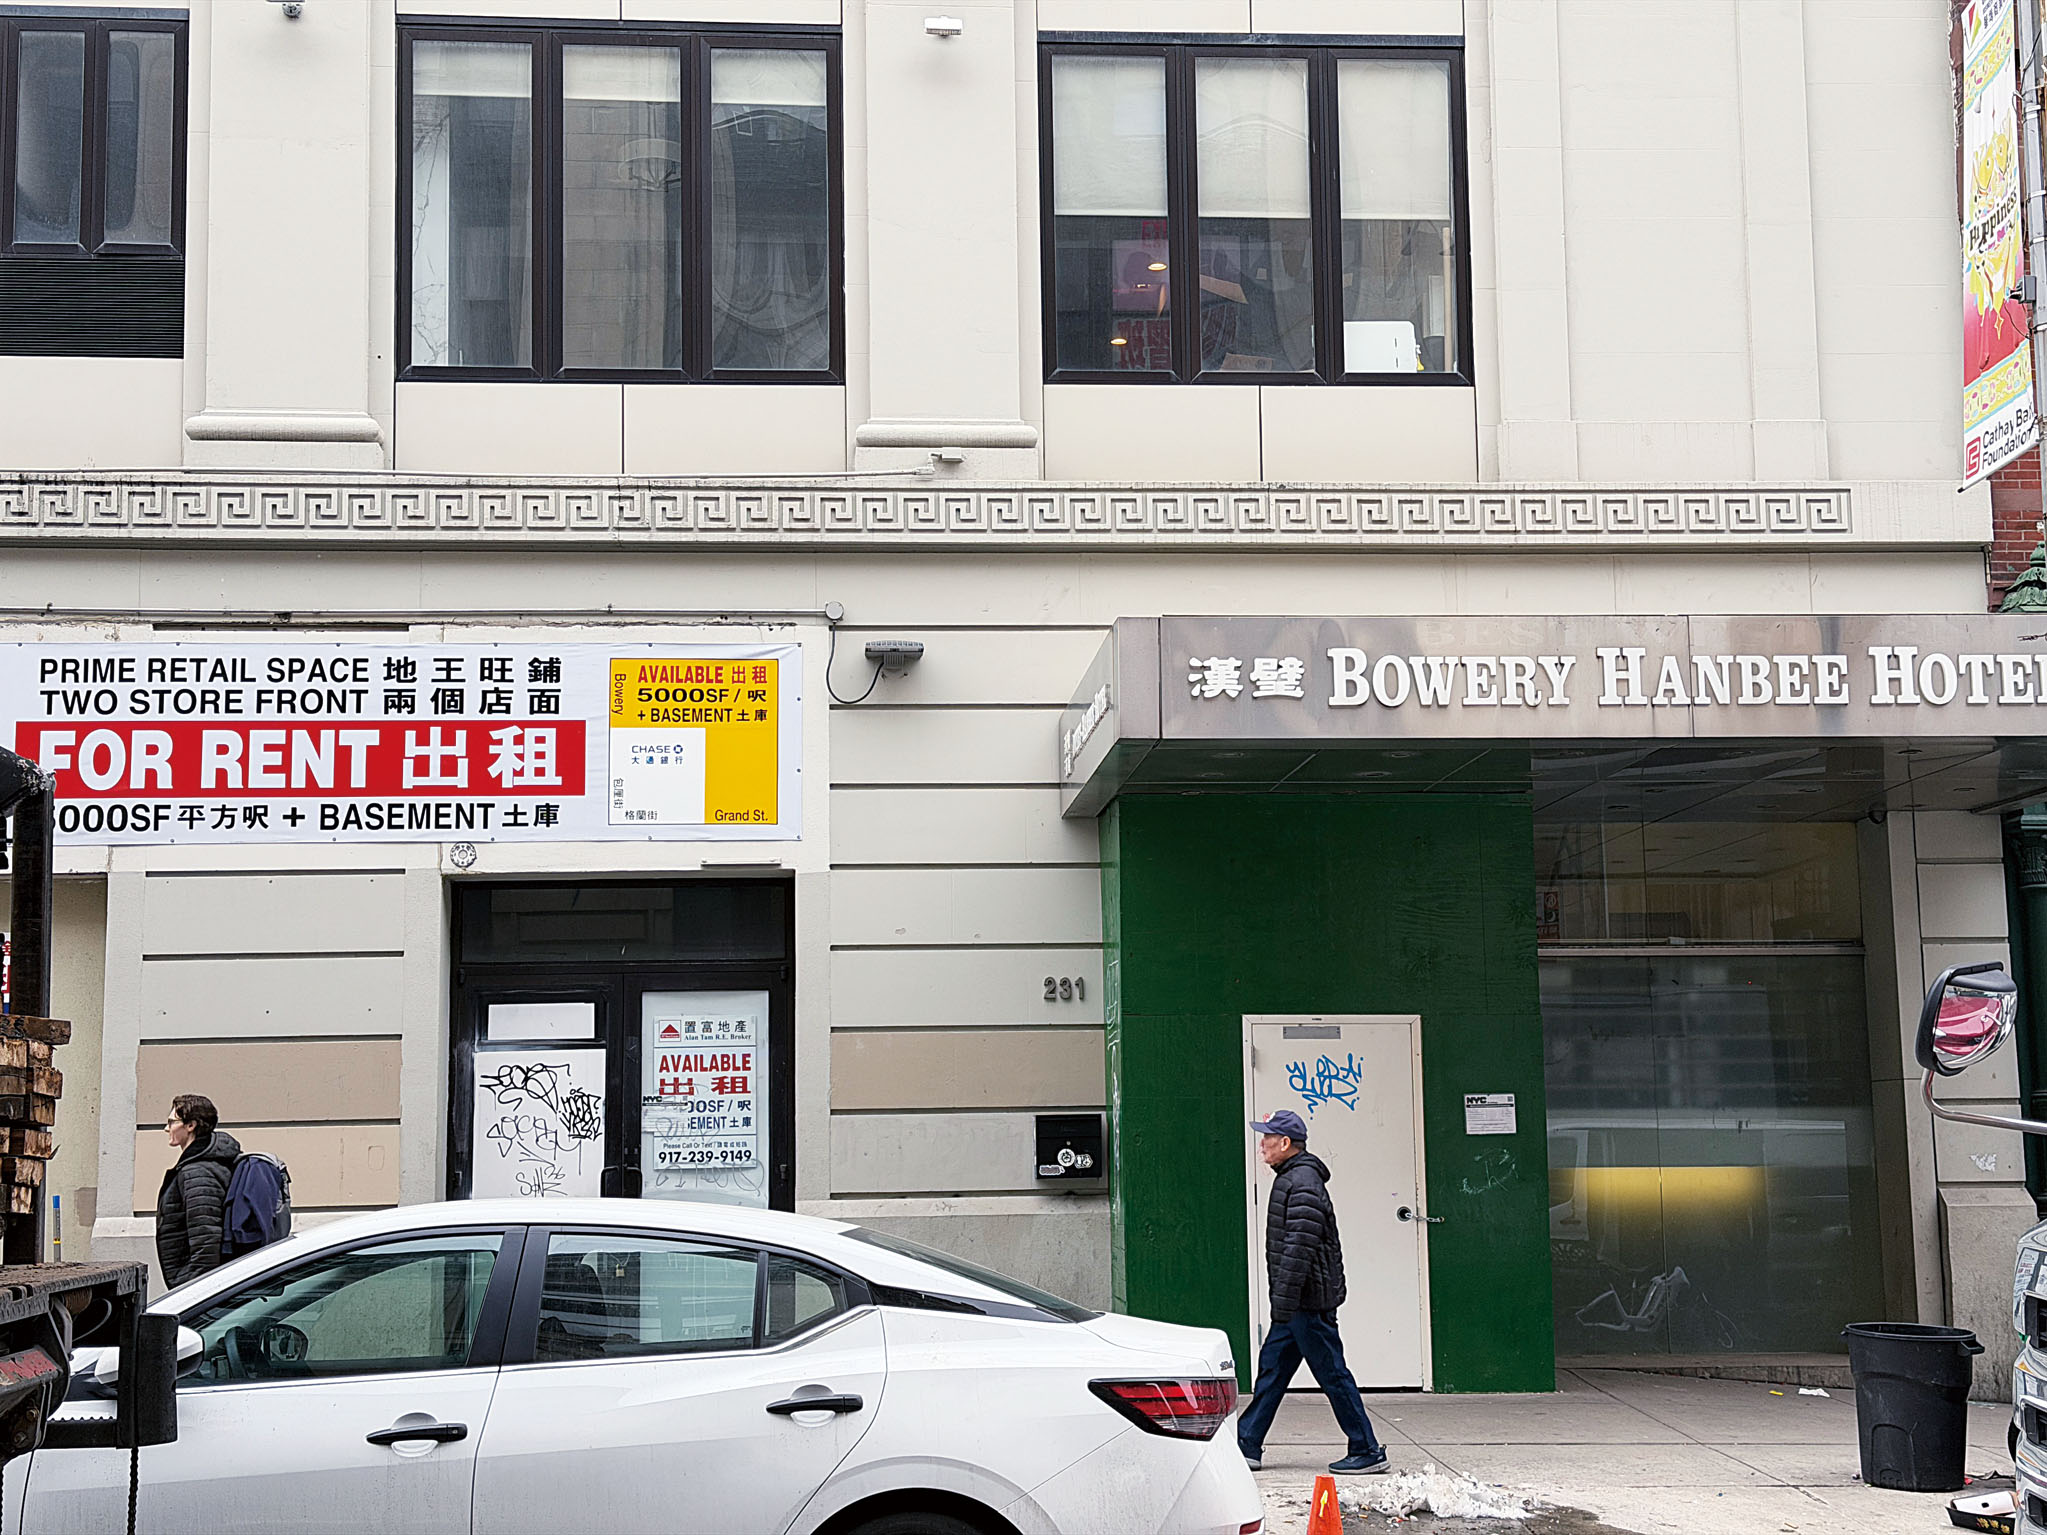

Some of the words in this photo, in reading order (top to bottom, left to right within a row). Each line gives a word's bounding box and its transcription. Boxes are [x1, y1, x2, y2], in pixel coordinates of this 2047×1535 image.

[1983, 420, 2014, 449] Cathay
[2016, 402, 2035, 428] Ba
[40, 658, 136, 683] PRIME
[148, 657, 257, 683] RETAIL
[266, 657, 369, 683] SPACE
[383, 656, 562, 684] 地王旺鋪
[637, 665, 724, 684] AVAILABLE
[731, 665, 768, 685] 出租
[1326, 647, 1577, 707] BOWERY
[1596, 647, 1850, 706] HANBEE
[40, 689, 118, 715] TWO
[129, 688, 243, 715] STORE
[256, 688, 369, 714] FRONT
[383, 687, 562, 715] 兩個店面
[611, 673, 627, 716] Bowery
[637, 688, 730, 703] 5000SF
[650, 708, 733, 723] BASEMENT
[736, 708, 768, 723] 土庫
[39, 728, 174, 791] FOR
[201, 728, 380, 789] RENT
[402, 725, 563, 789] 出租
[631, 745, 671, 754] CHASE
[52, 803, 172, 833] 000SF
[319, 802, 496, 831] BASEMENT
[501, 803, 561, 828] 土庫
[714, 809, 750, 822] Grand
[752, 809, 769, 822] St.
[1044, 976, 1086, 1002] 231
[684, 1020, 747, 1034] 置富地產
[658, 1053, 752, 1073] AVAILABLE
[658, 1075, 752, 1096] 出租
[642, 1095, 663, 1103] NYC
[687, 1099, 725, 1114] 00SF
[1466, 1096, 1488, 1104] NYC
[687, 1115, 728, 1130] EMENT
[729, 1115, 753, 1129] 土庫
[694, 1141, 701, 1149] Or
[658, 1150, 752, 1164] 917-239-9149
